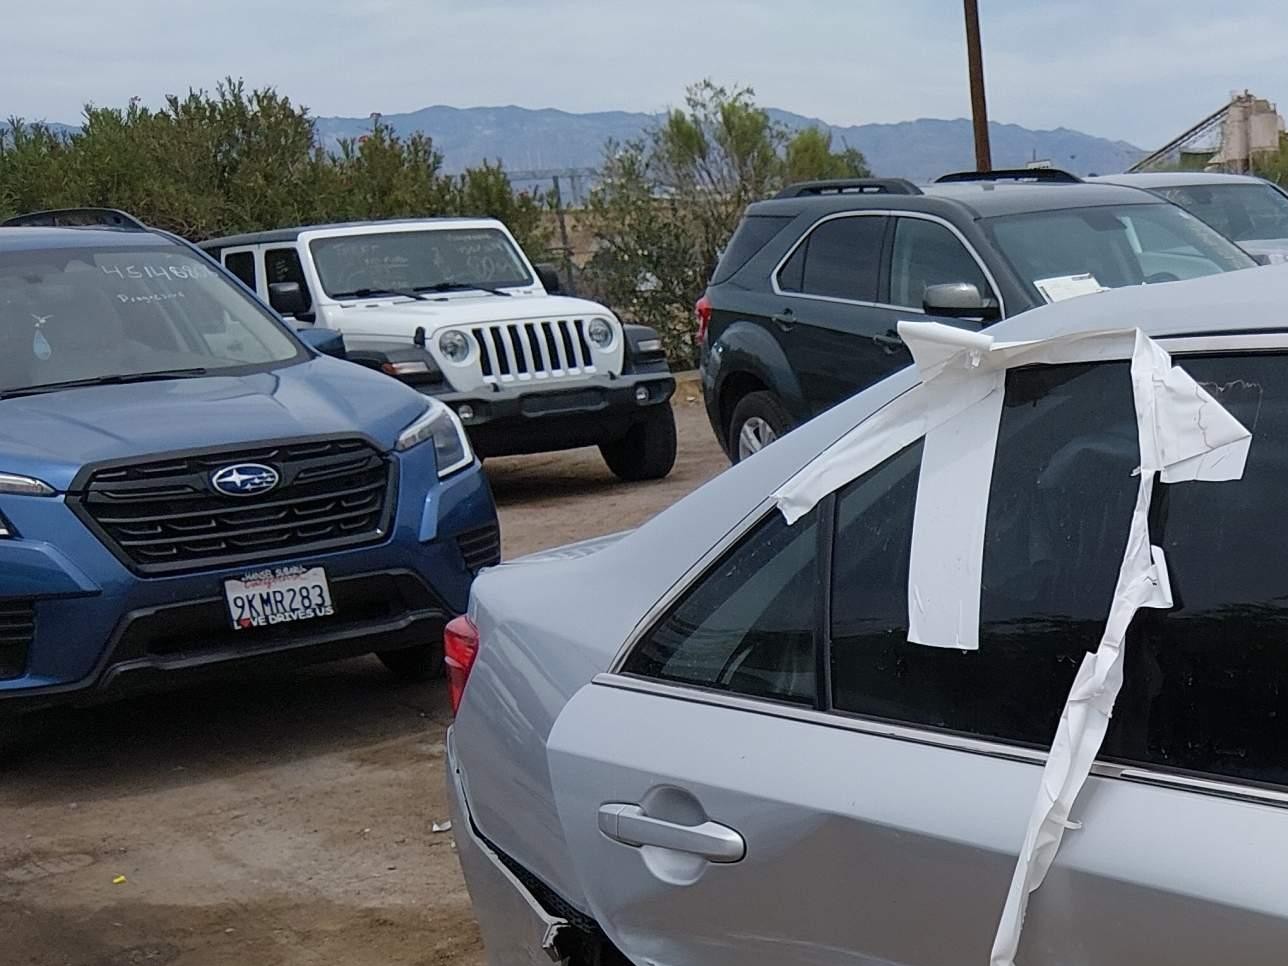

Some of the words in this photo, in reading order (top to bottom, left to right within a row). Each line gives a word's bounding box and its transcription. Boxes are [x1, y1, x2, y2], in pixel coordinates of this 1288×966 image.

[233, 585, 325, 621] 9KMR283
[268, 607, 314, 624] DRIVES
[315, 605, 334, 616] US
